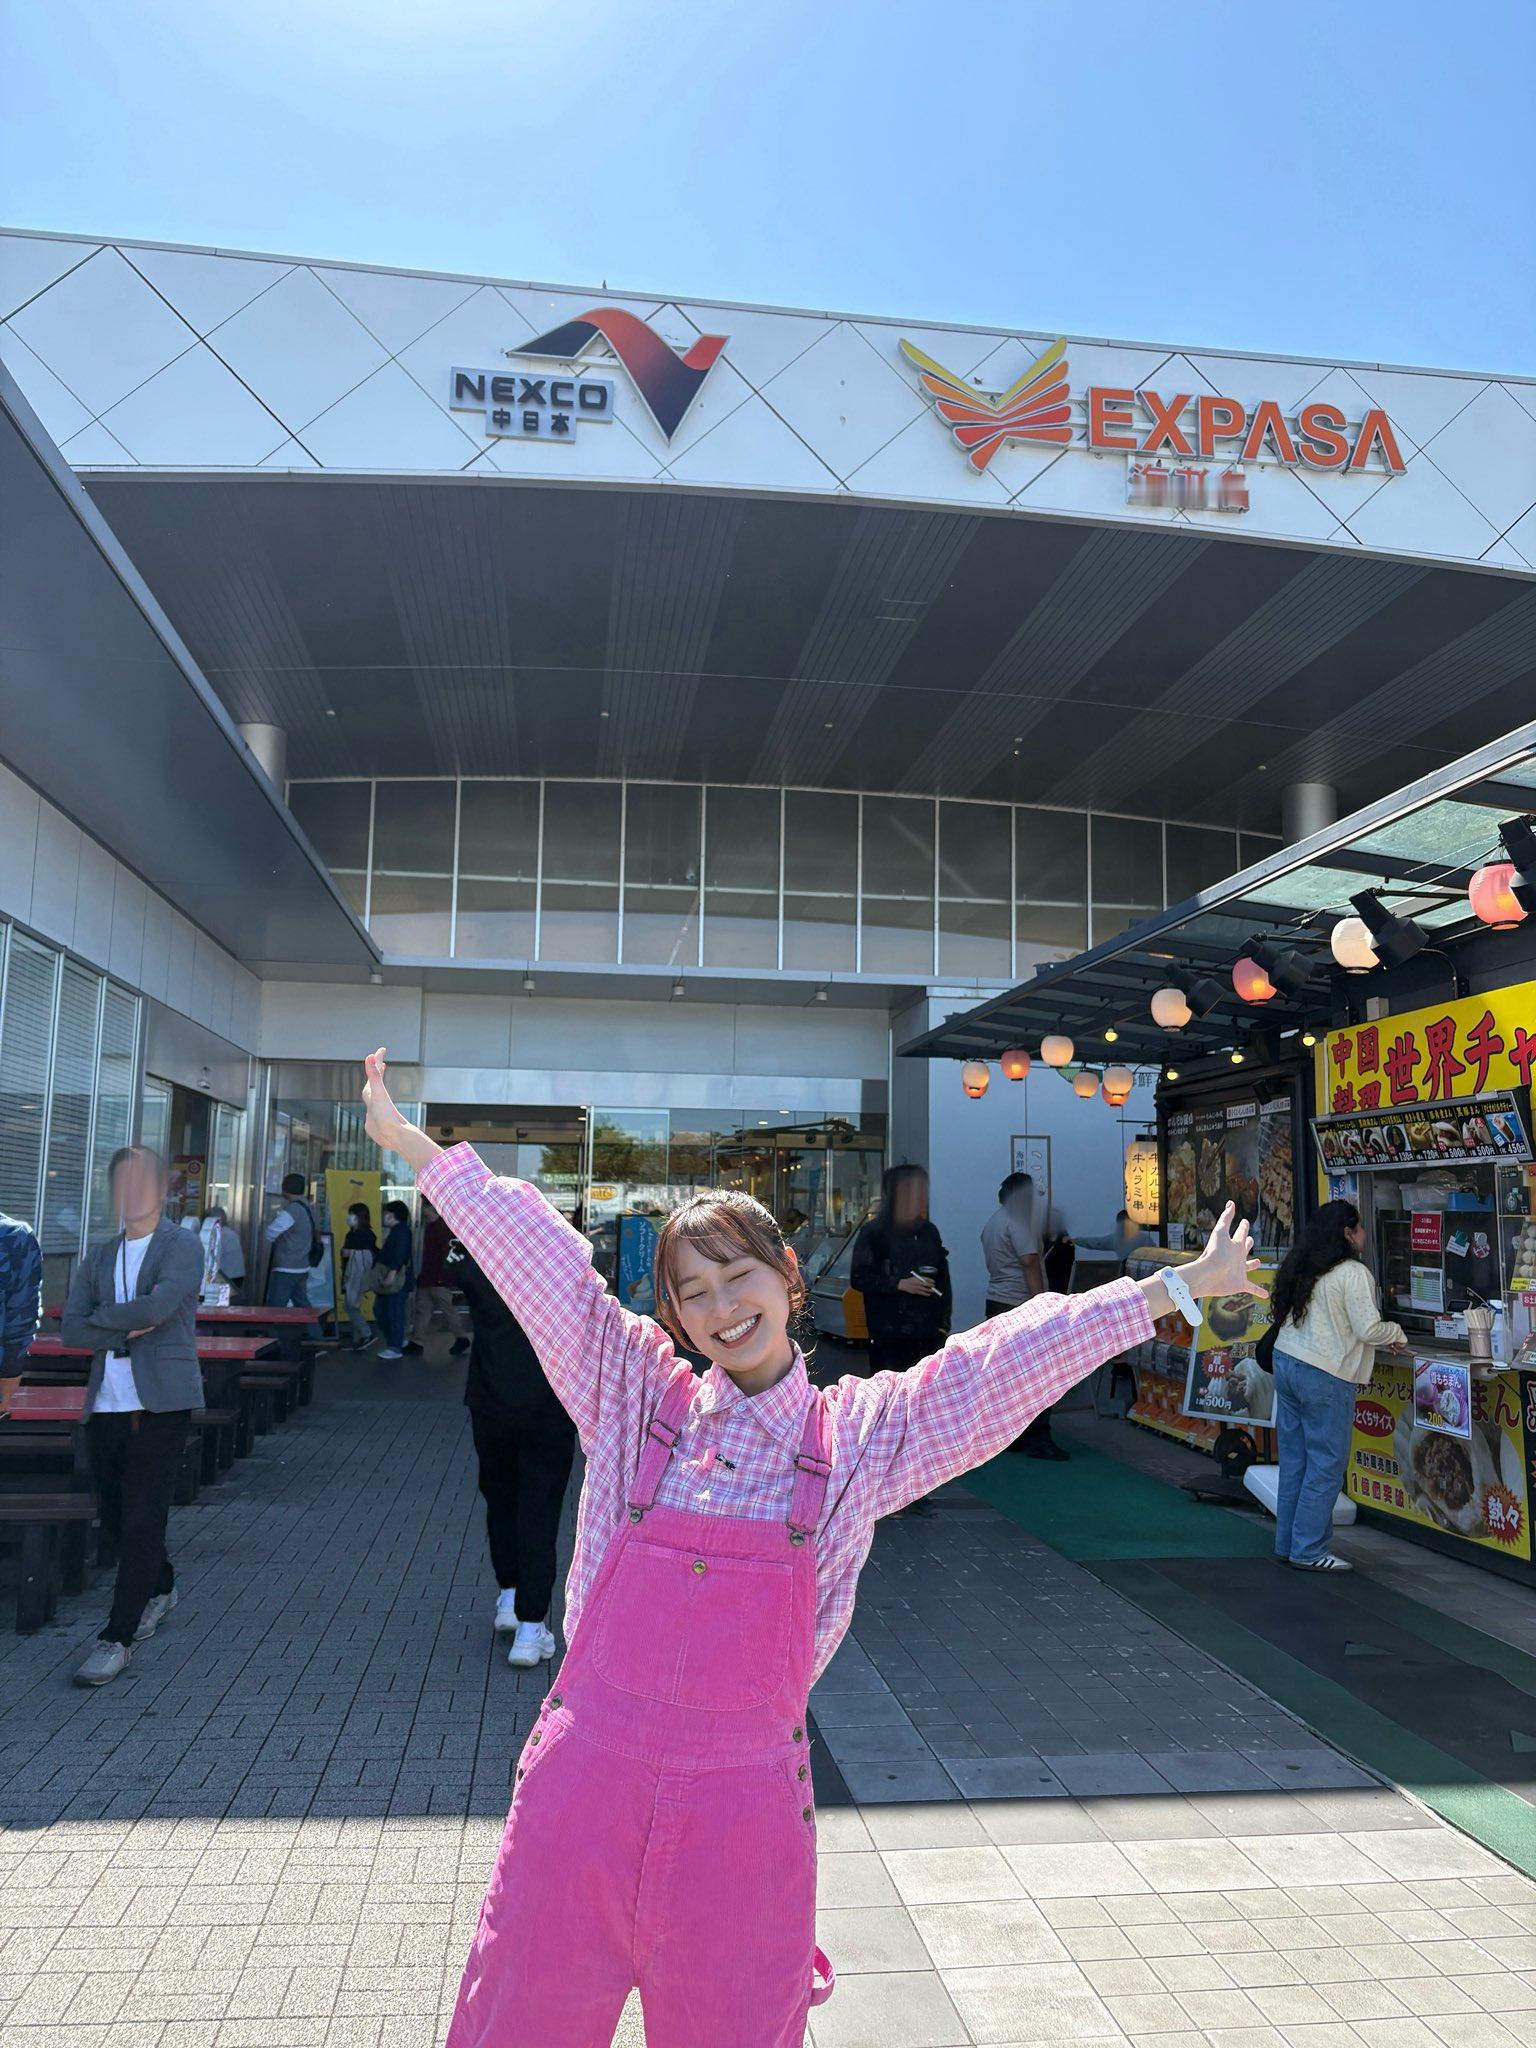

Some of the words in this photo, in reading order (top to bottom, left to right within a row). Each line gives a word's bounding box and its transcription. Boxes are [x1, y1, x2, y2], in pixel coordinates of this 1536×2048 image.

[455, 372, 608, 410] NEXCO
[492, 407, 570, 433] 中日本
[1088, 385, 1407, 477] EXPASA
[1331, 1025, 1379, 1079] 中国
[1132, 1152, 1145, 1211] 牛ハラミ串
[1207, 1364, 1225, 1373] BIG
[1488, 1495, 1520, 1531] 熱々
